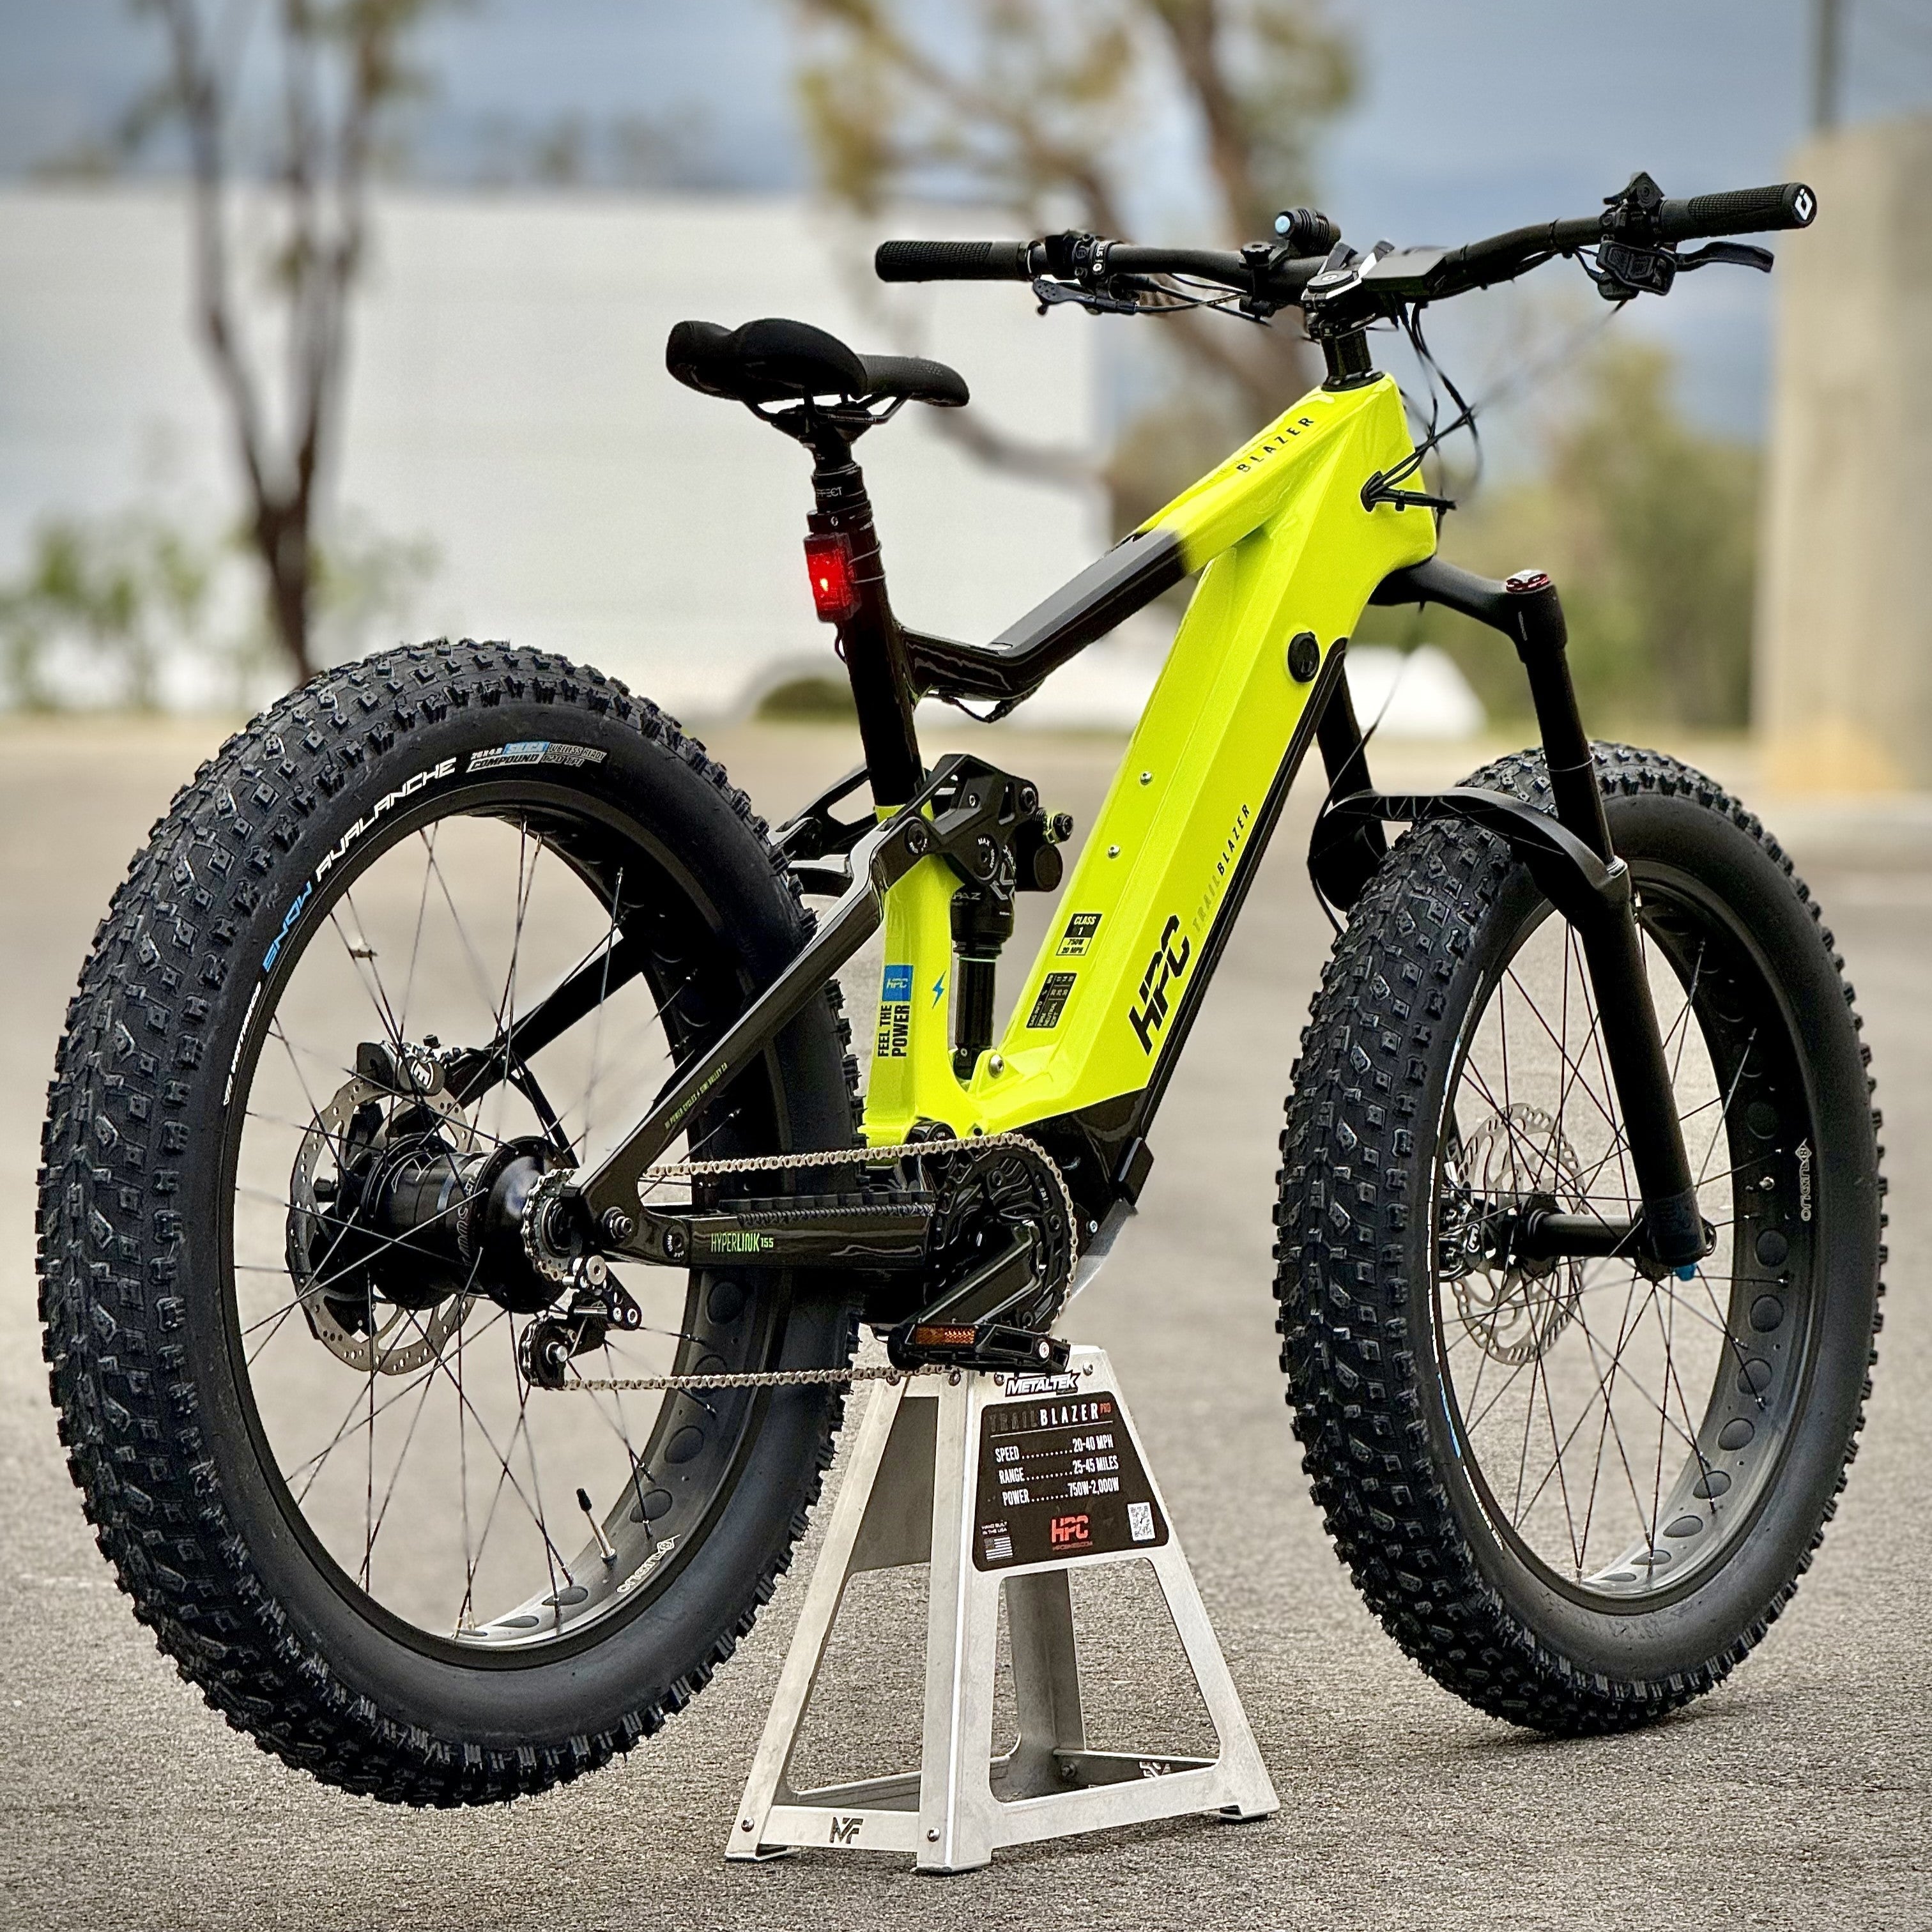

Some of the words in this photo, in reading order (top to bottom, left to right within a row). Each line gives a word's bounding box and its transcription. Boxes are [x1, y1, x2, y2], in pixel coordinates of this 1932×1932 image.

[262, 880, 312, 972] SNOW
[315, 757, 457, 882] AVALANCHE
[1073, 916, 1097, 925] CLASS
[1078, 926, 1084, 935] 1
[886, 977, 908, 989] HPC
[1128, 914, 1190, 1056] HPC
[879, 1004, 893, 1027] THE
[878, 1029, 891, 1057] FEEL
[891, 1004, 910, 1057] POWER
[1007, 1374, 1077, 1395] METALTEK
[995, 1445, 1020, 1463] SPEED
[1072, 1437, 1096, 1453] 20-40
[1096, 1434, 1114, 1449] MPH
[999, 1467, 1024, 1484] RANGE
[1072, 1458, 1096, 1473] 25-45
[1096, 1455, 1119, 1471] MILES
[1002, 1488, 1031, 1506] POWER
[1068, 1476, 1119, 1498] 750W-2,000W
[1051, 1515, 1089, 1544] HPC
